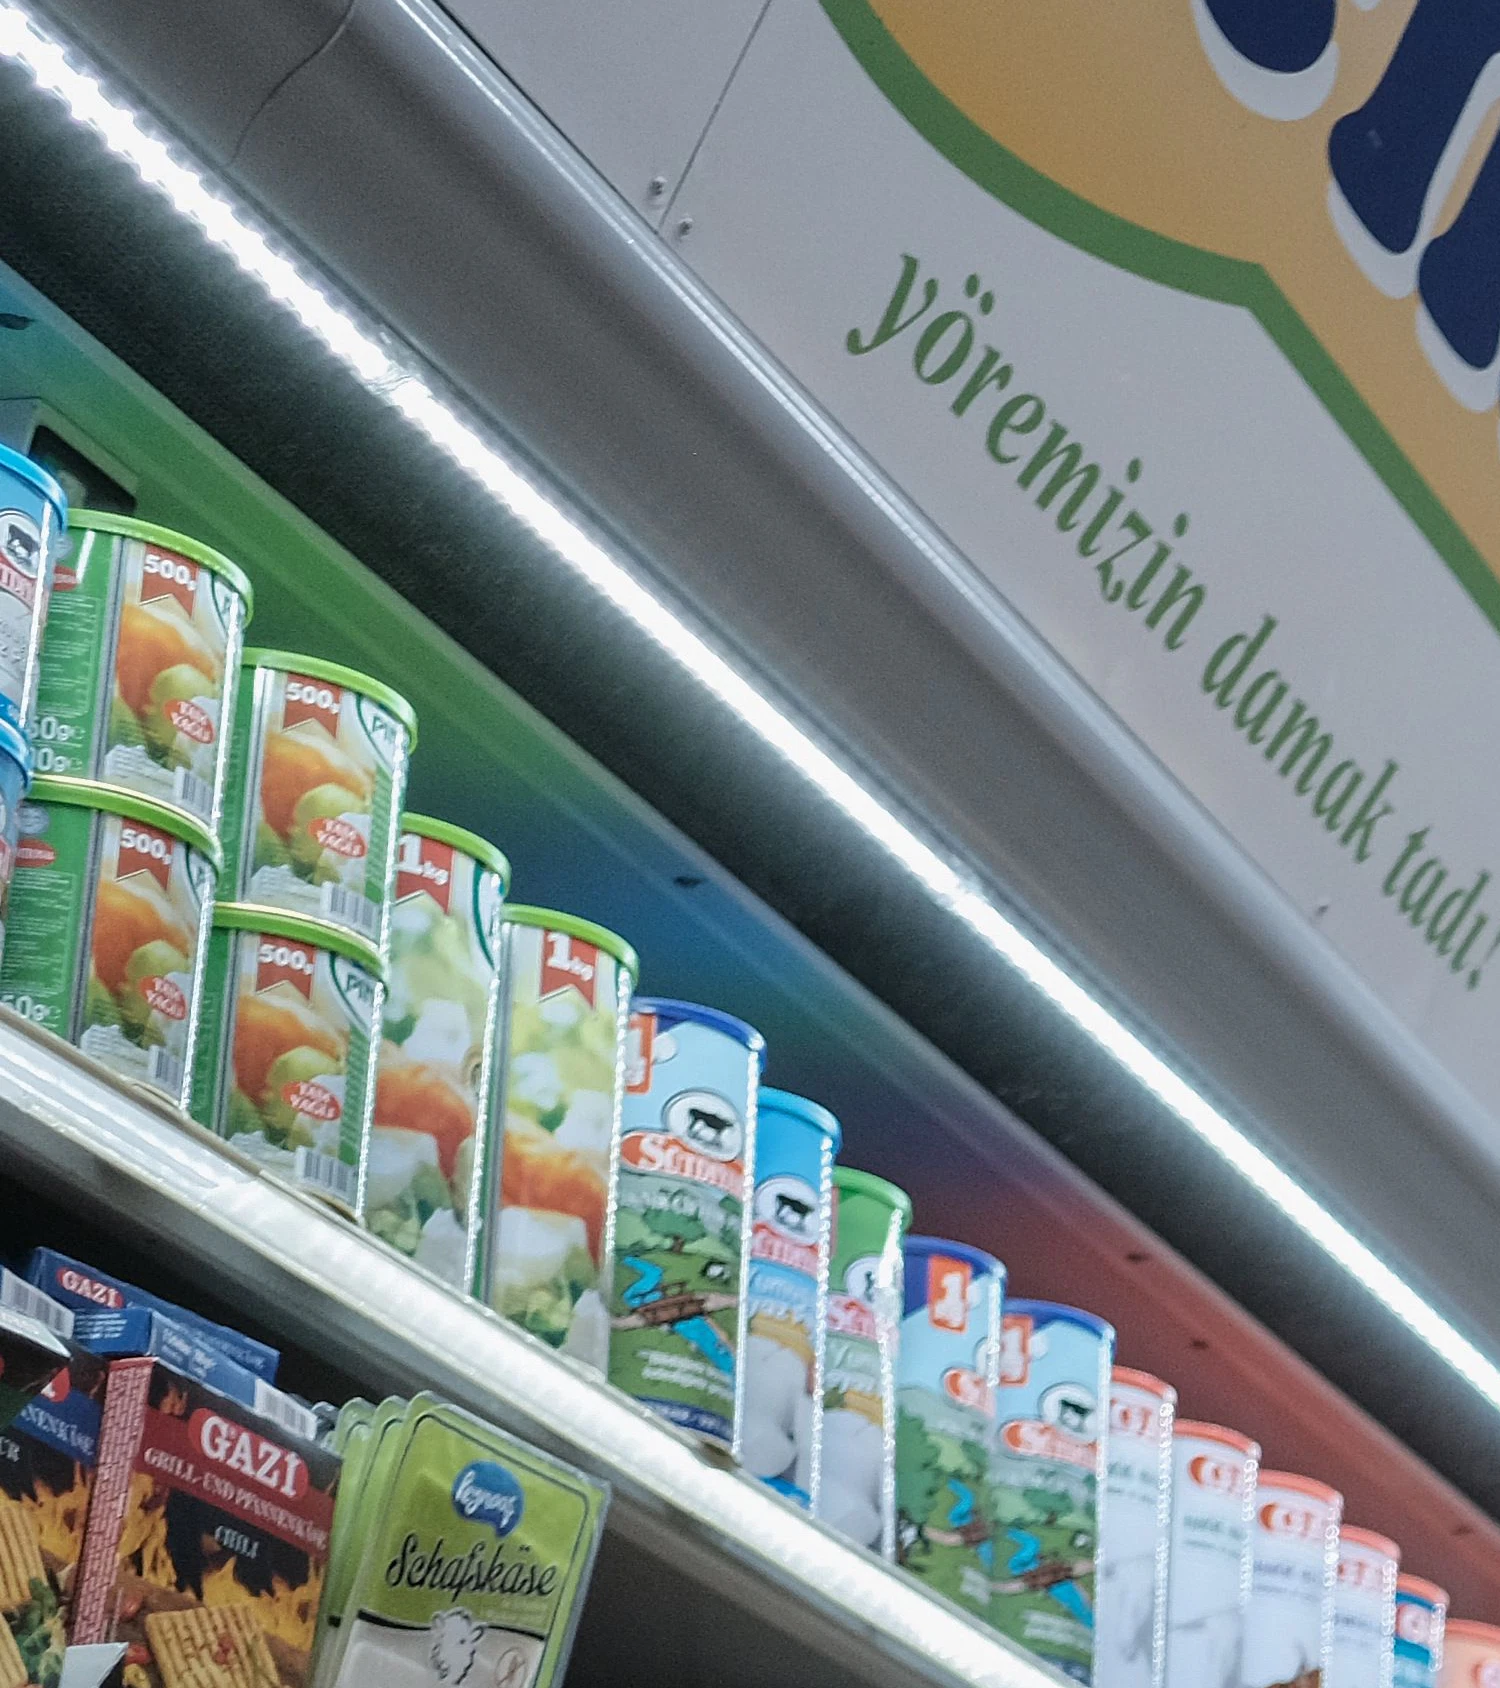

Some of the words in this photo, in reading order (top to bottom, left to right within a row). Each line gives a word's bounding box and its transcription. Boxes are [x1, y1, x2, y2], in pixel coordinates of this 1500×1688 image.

[846, 252, 1208, 653] yöremizin
[1200, 614, 1404, 868] damak
[200, 1415, 302, 1498] GAZI
[384, 1532, 559, 1603] Schafskäse
